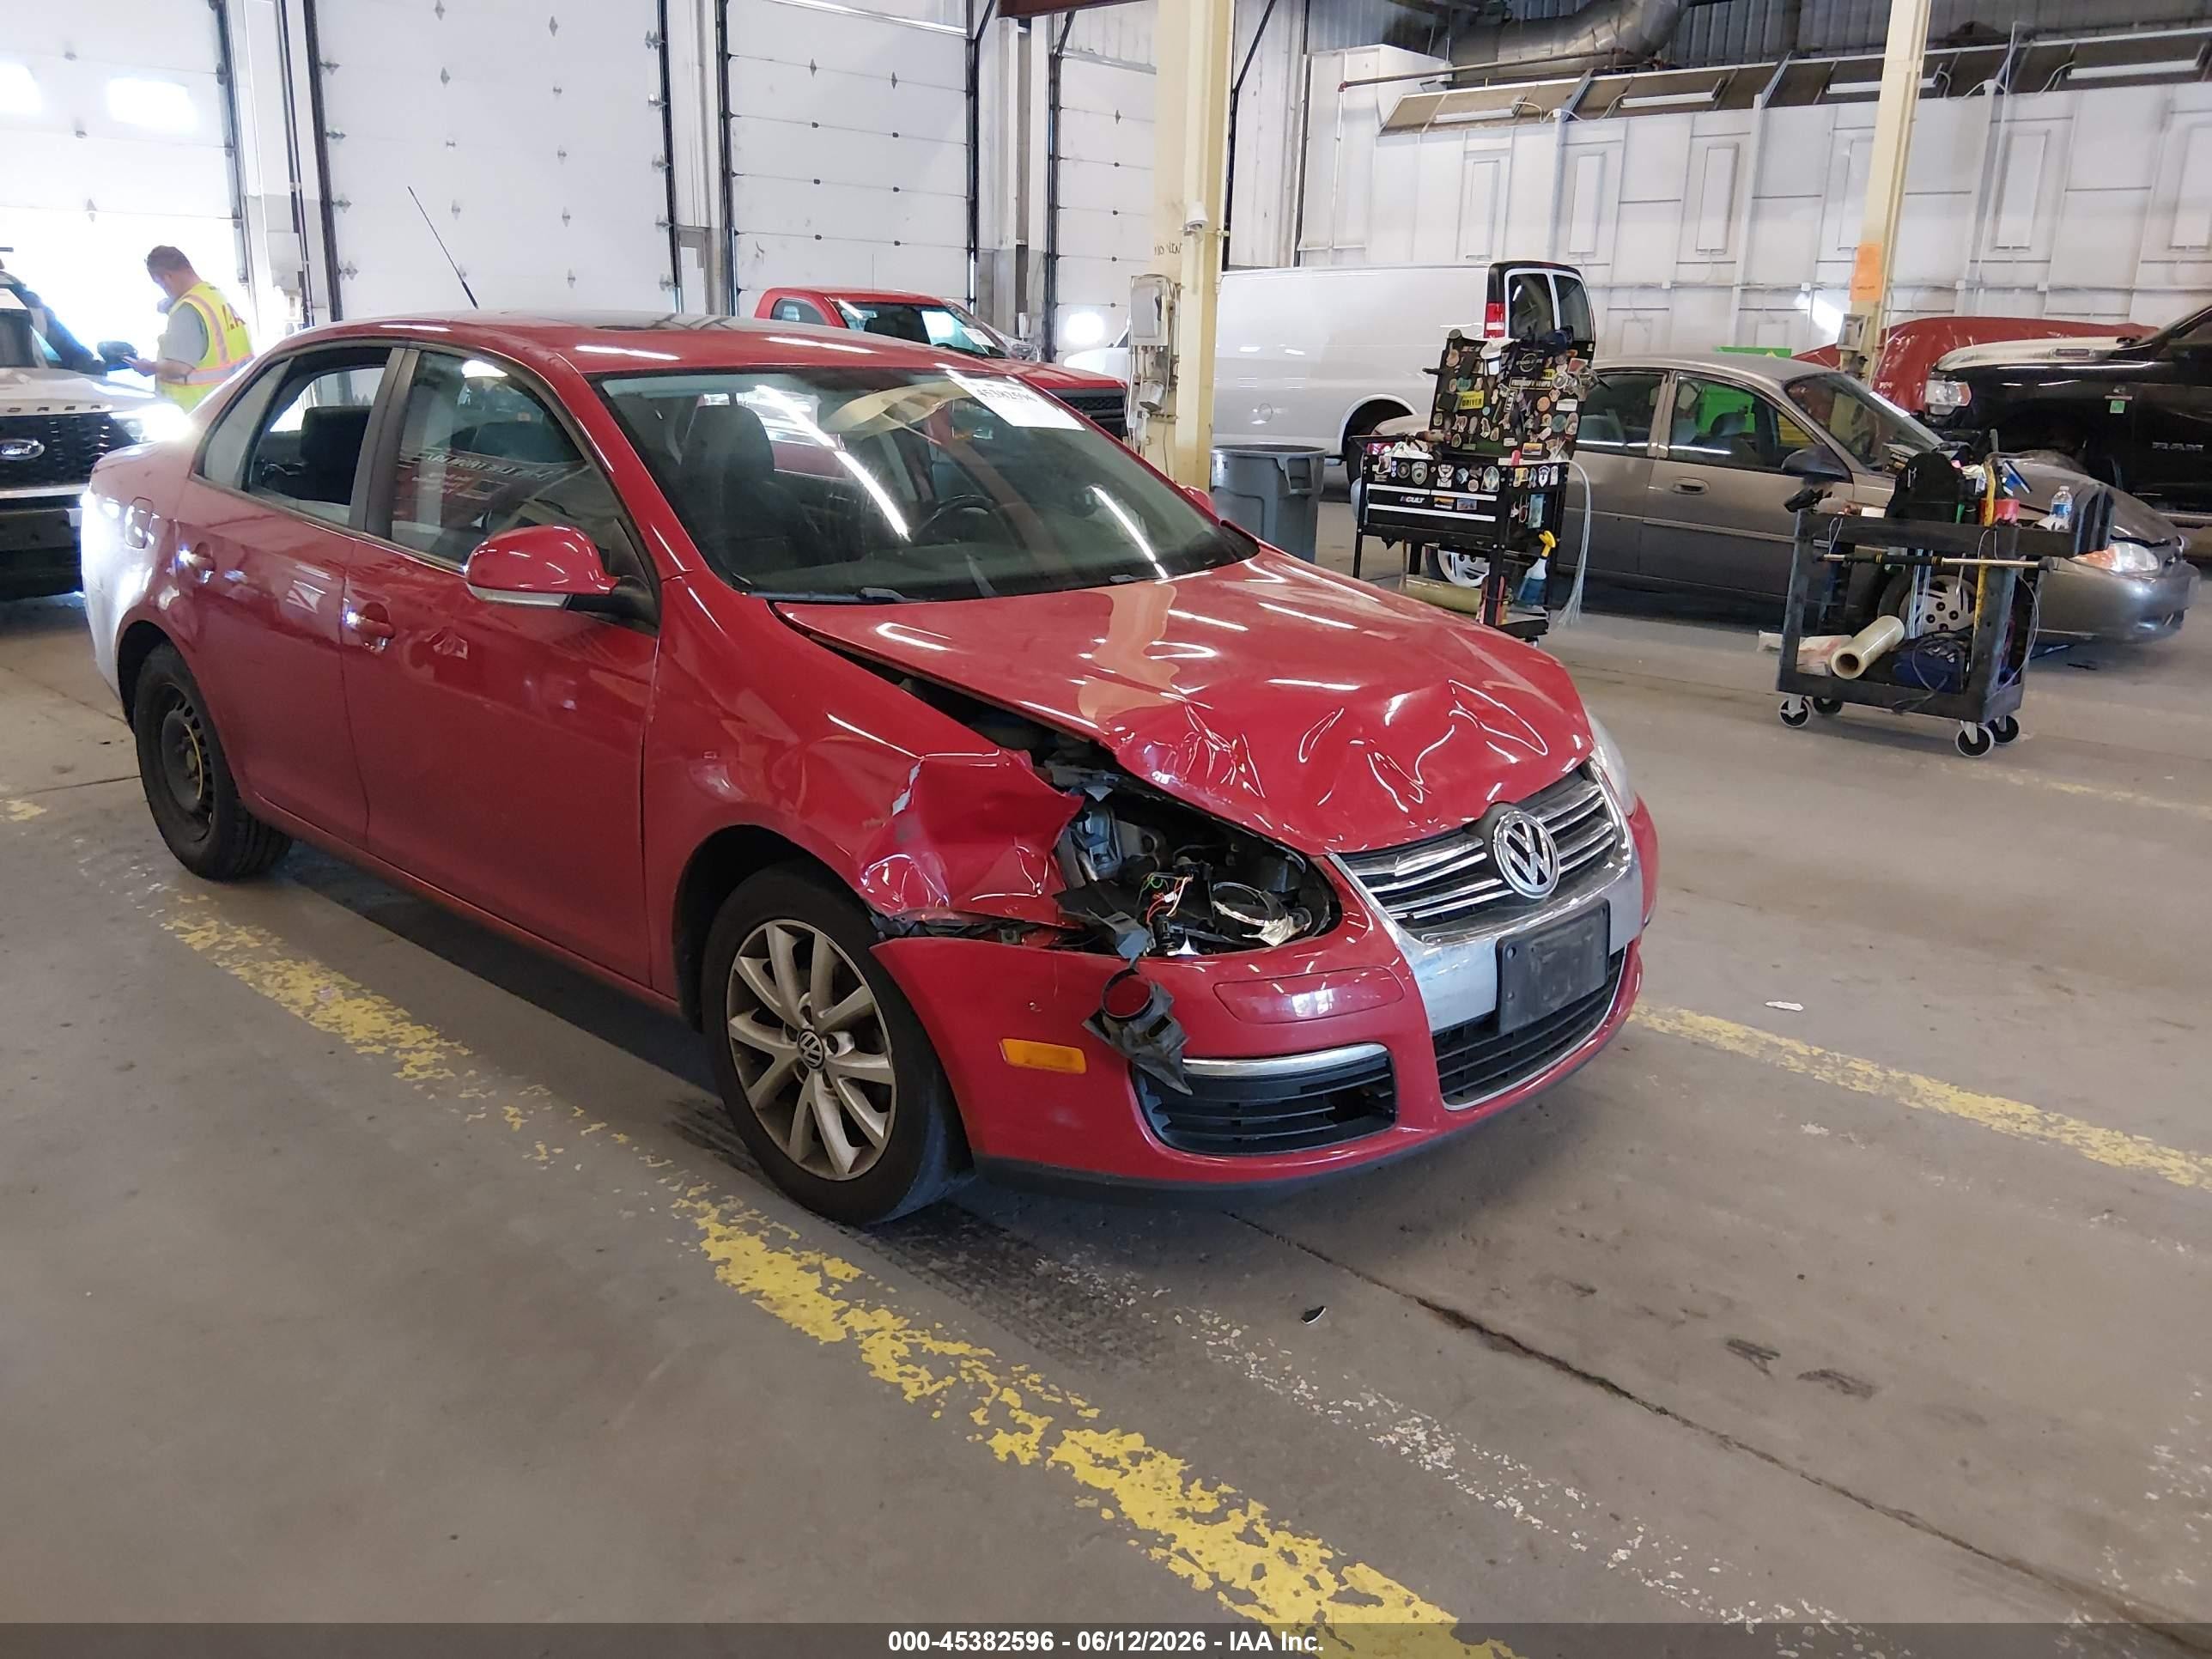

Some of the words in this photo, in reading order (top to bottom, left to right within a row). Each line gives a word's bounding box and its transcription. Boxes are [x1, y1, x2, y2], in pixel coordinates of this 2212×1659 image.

[1462, 398, 1482, 407] DRIVER
[2151, 441, 2205, 452] RAM
[1497, 815, 1555, 893] VW
